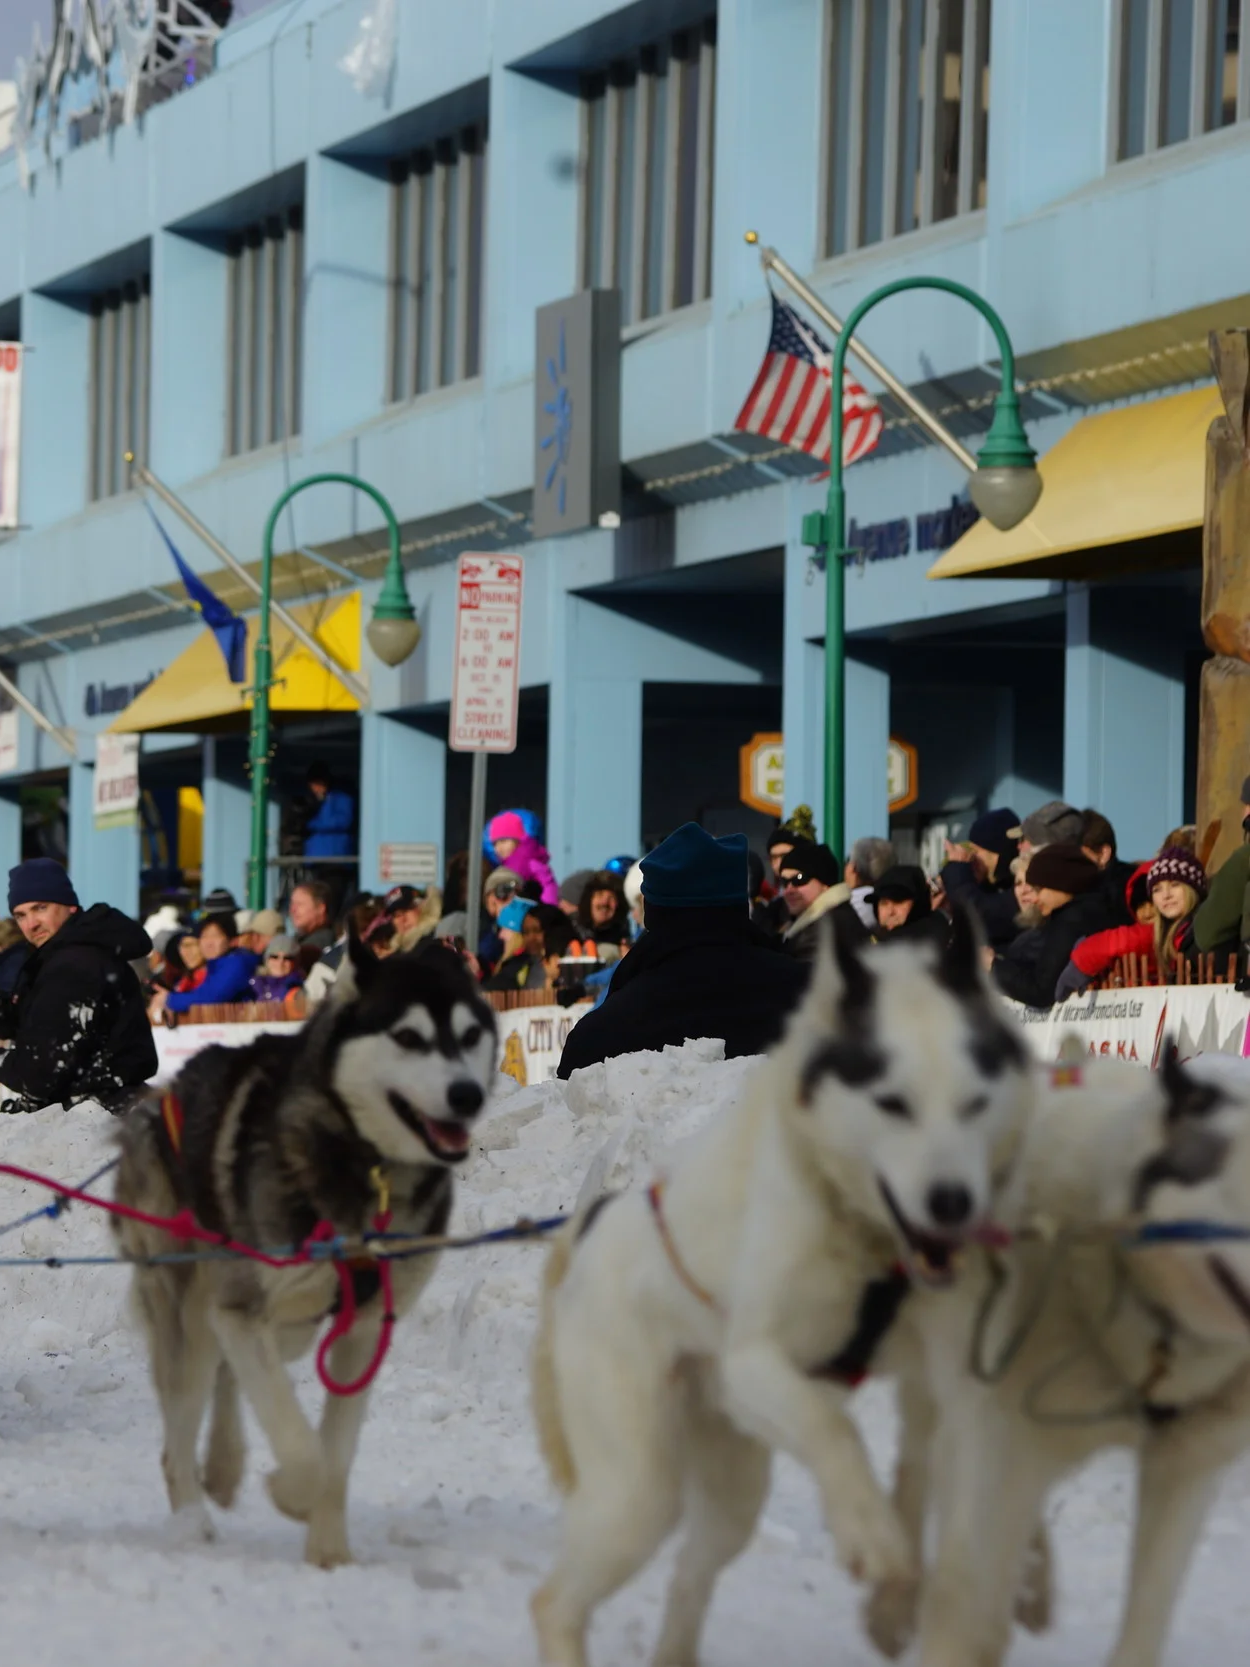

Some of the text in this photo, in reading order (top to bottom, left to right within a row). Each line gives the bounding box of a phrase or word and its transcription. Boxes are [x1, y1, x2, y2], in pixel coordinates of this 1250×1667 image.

[498, 631, 514, 641] AM
[497, 656, 513, 668] AM
[464, 711, 504, 724] STREET
[456, 727, 511, 740] CLEANING
